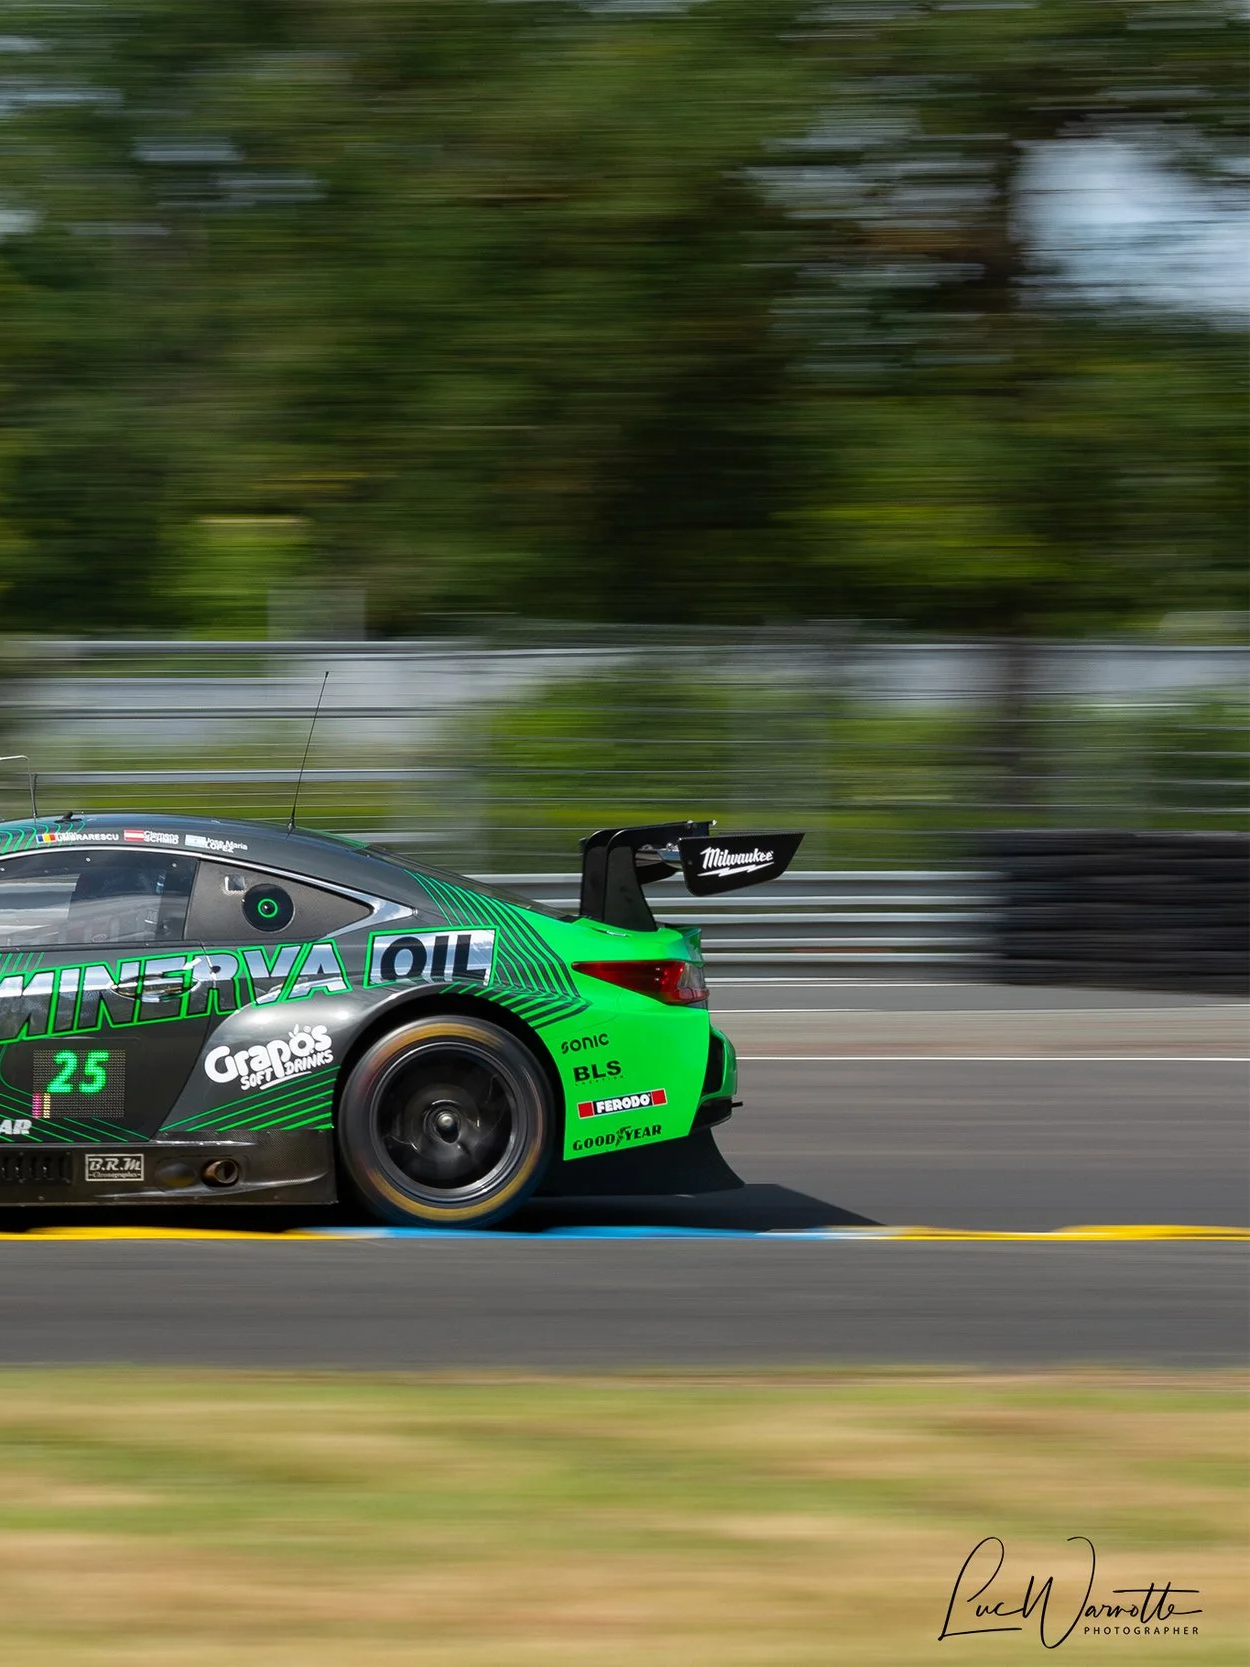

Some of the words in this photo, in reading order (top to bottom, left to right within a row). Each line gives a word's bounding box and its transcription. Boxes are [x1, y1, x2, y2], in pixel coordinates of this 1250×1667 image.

[700, 847, 774, 869] Milwaukee
[379, 934, 487, 982] OIL
[46, 1050, 110, 1093] 25
[240, 1068, 274, 1090] SOFT
[284, 1050, 334, 1075] DRINKS
[573, 1060, 622, 1082] BLS
[596, 1094, 650, 1113] FERODO
[572, 1124, 662, 1150] GOODYEAR
